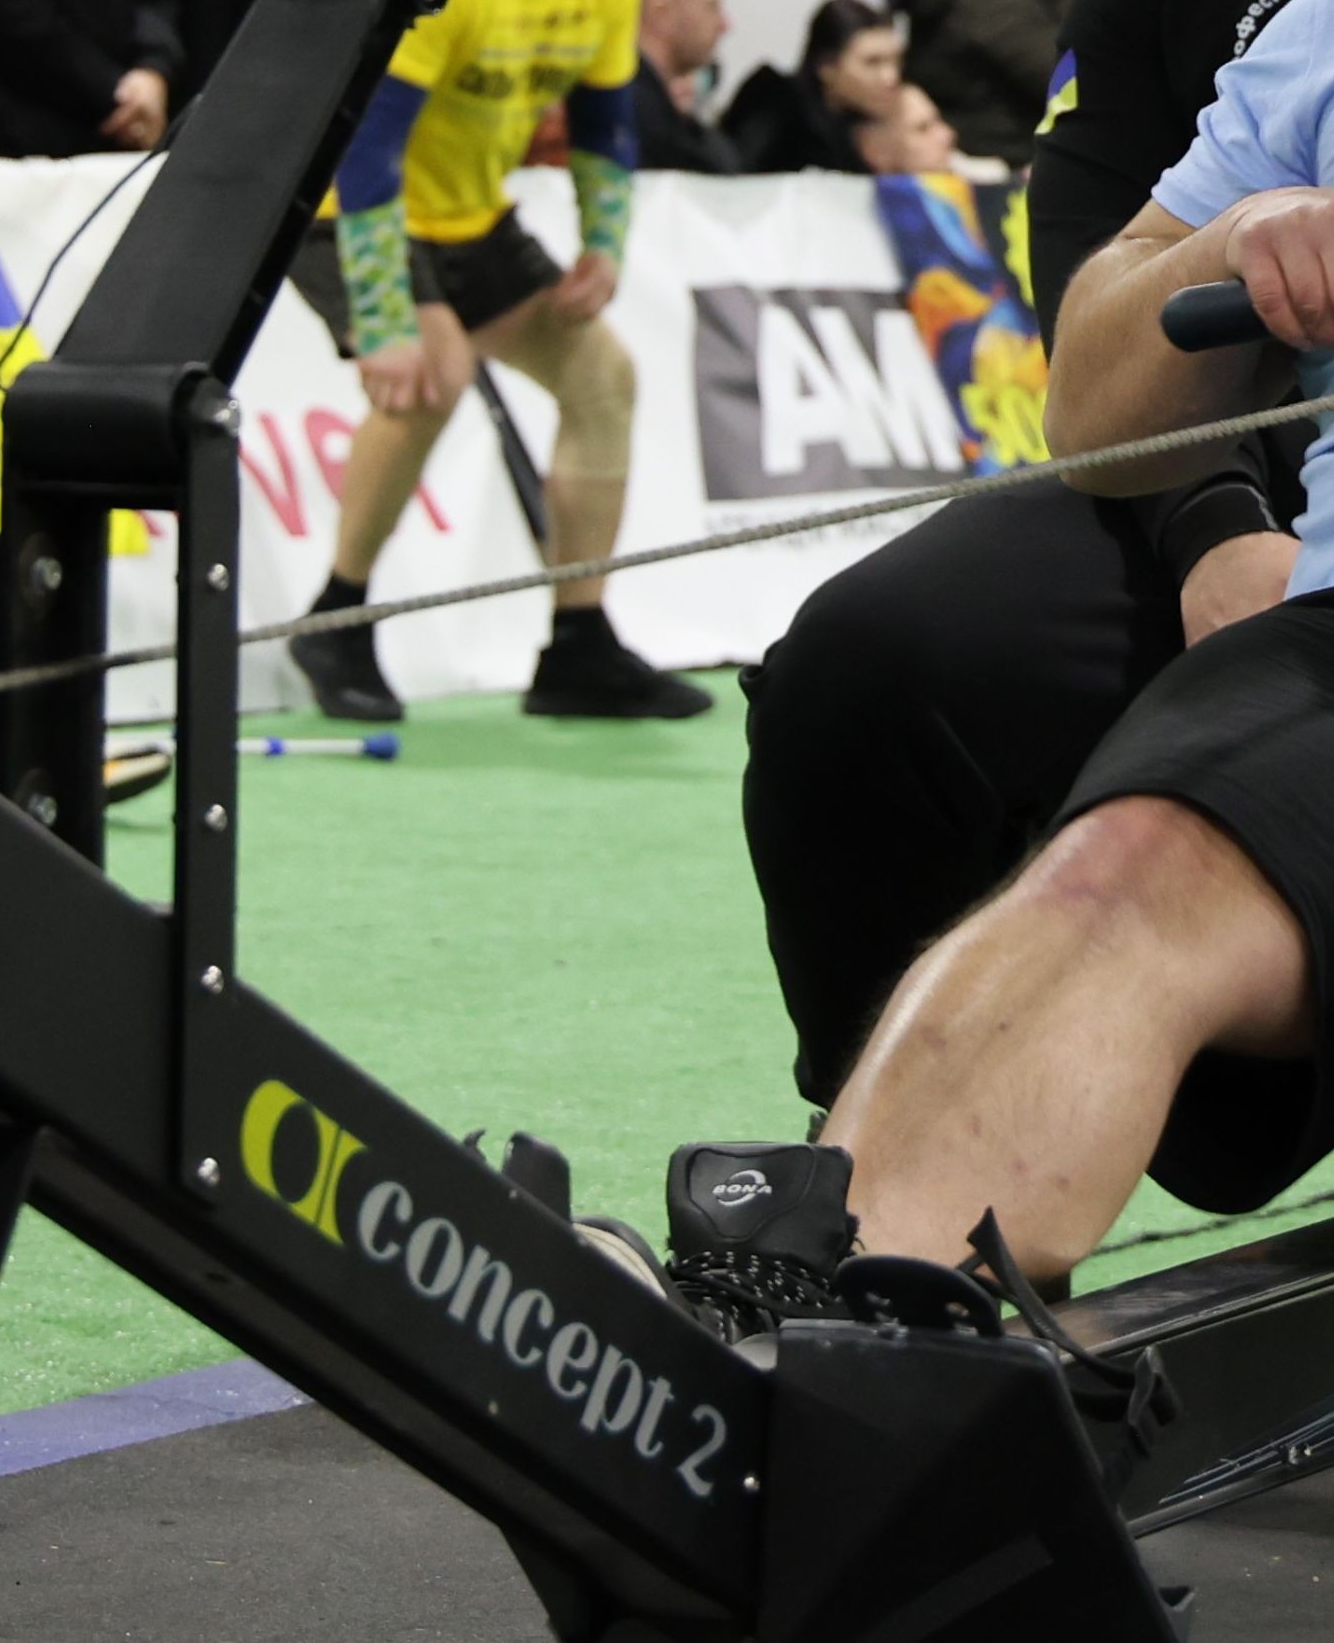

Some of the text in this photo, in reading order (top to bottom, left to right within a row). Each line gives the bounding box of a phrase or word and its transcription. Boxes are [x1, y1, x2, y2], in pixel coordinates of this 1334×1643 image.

[712, 1184, 772, 1194] BONA
[358, 1181, 726, 1497] concept 2
